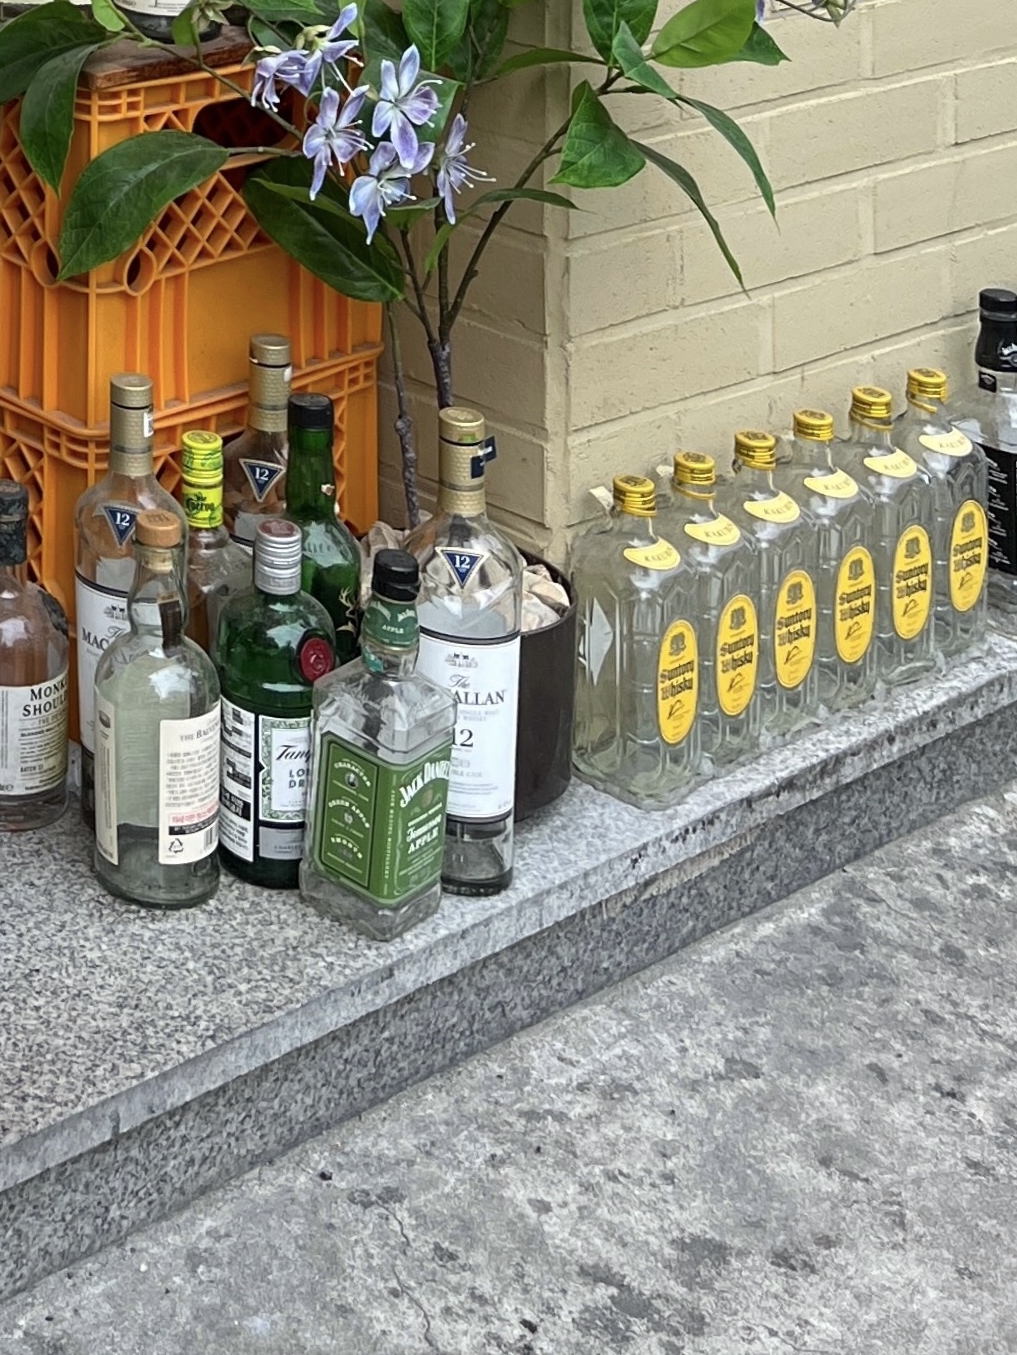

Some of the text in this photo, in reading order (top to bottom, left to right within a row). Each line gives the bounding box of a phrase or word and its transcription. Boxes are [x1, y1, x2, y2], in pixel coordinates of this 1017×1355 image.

[255, 467, 269, 480] 12
[116, 512, 130, 527] 12
[454, 555, 471, 570] 12
[776, 607, 813, 630] Suntory
[720, 633, 755, 657] Suntory
[777, 624, 811, 647] Whisky
[660, 659, 694, 684] Suntory
[721, 650, 753, 674] Whisky
[661, 676, 693, 701] Whisky
[452, 727, 474, 748] 12
[289, 779, 305, 789] DR
[399, 771, 424, 808] JACK
[408, 826, 439, 855] APPLE
